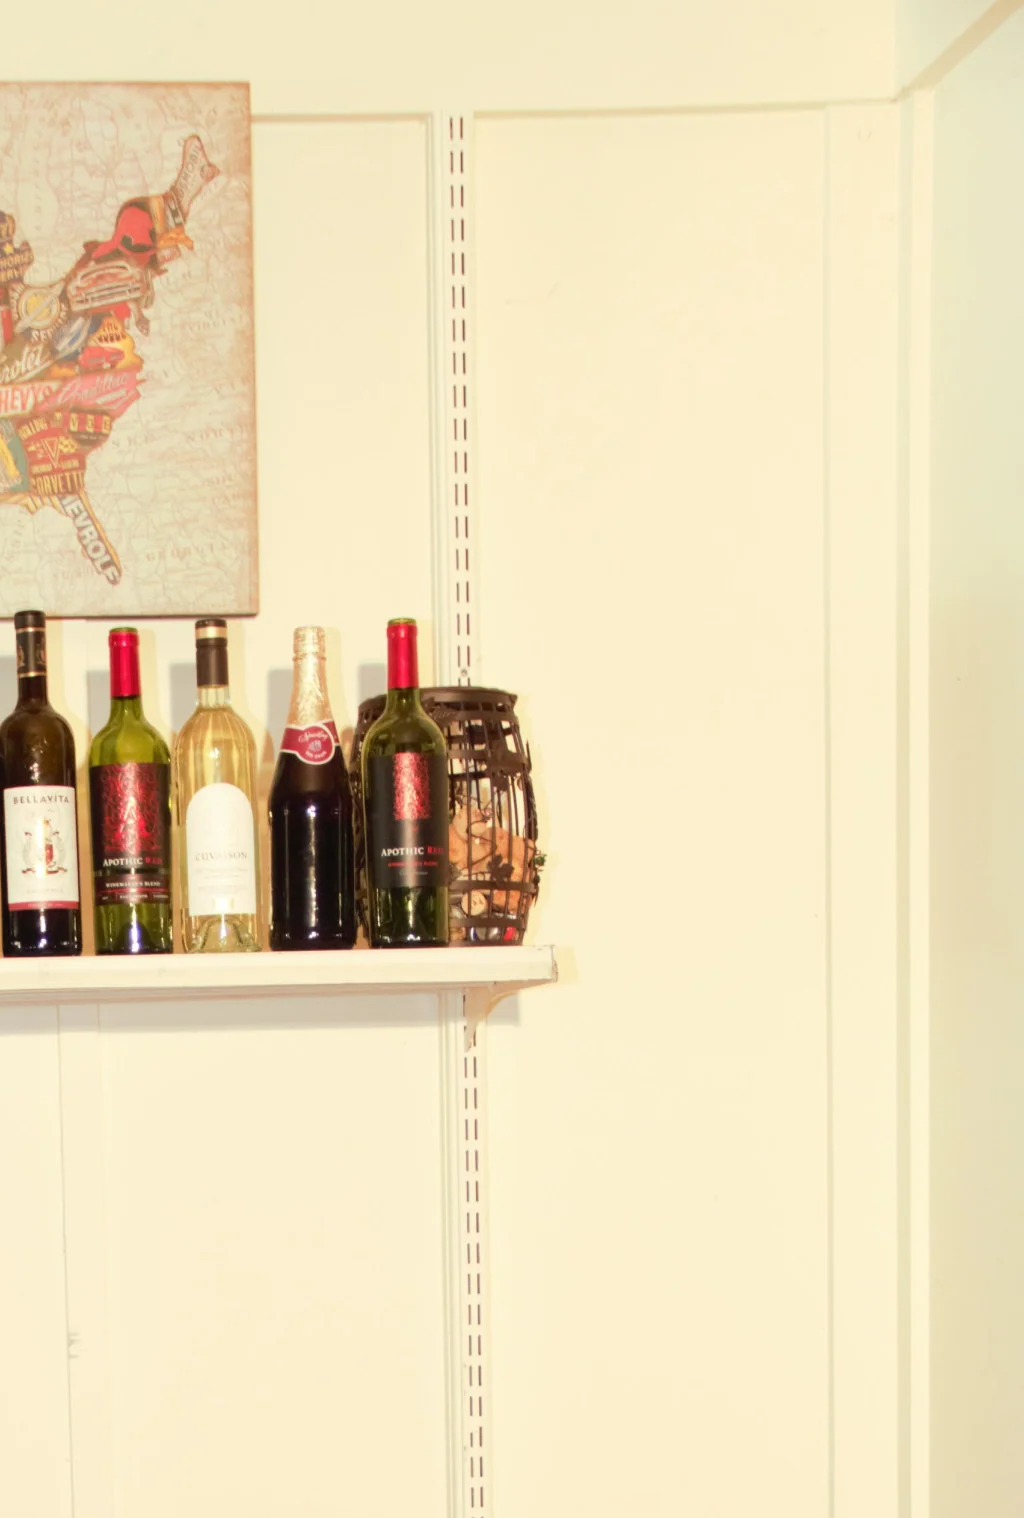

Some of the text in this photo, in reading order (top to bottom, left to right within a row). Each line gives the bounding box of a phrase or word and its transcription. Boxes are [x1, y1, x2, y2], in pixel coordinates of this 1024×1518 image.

[13, 795, 70, 805] BELLAVITA
[381, 846, 425, 857] APOTHIC
[102, 856, 144, 867] APOTHIC
